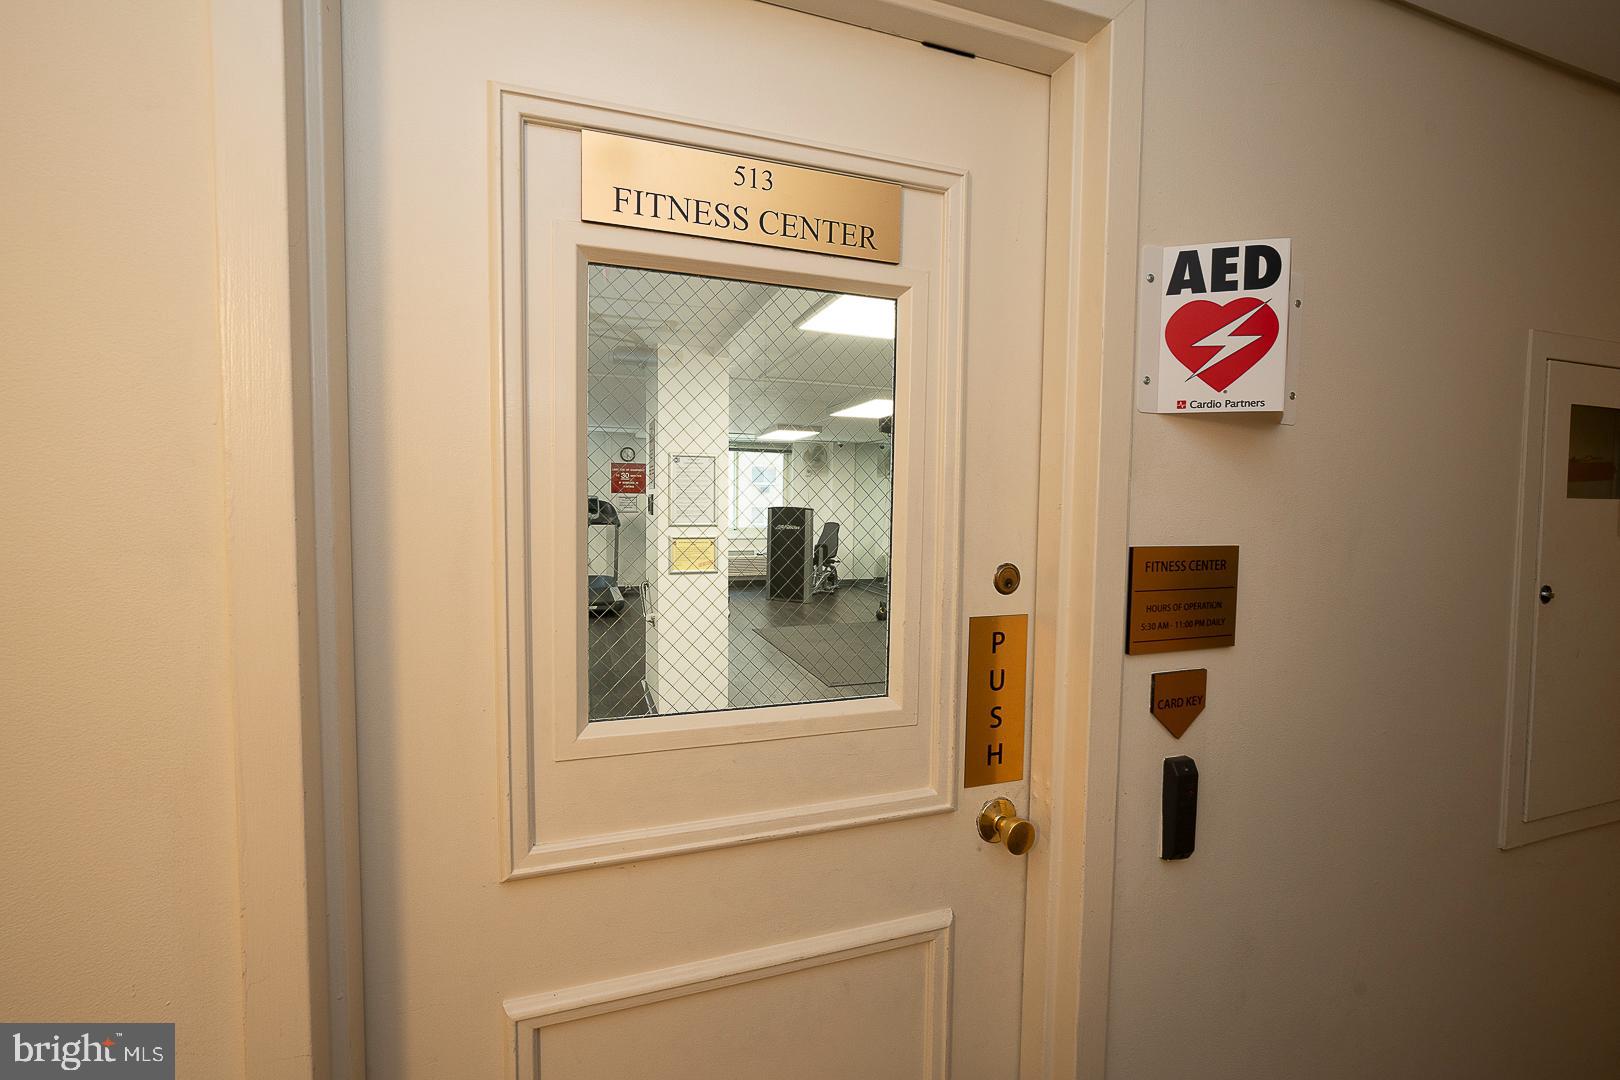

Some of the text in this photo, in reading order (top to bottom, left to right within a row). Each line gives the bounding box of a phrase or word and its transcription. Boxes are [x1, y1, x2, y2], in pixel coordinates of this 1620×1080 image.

[733, 166, 774, 191] 513
[613, 186, 879, 250] FITNESS CENTER
[1166, 244, 1282, 296] AED
[1189, 399, 1266, 409] Cardio Partners
[1145, 559, 1227, 573] FITNESS CENTER
[1146, 600, 1224, 613] HOURS OF OPERATION
[1140, 622, 1156, 631] 5:30
[1157, 621, 1169, 630] AM
[1175, 620, 1193, 628] 11:00
[1194, 619, 1205, 627] PM
[1206, 617, 1226, 626] DAILY
[987, 631, 1006, 766] PUSH
[1157, 695, 1204, 710] CARD KEY
